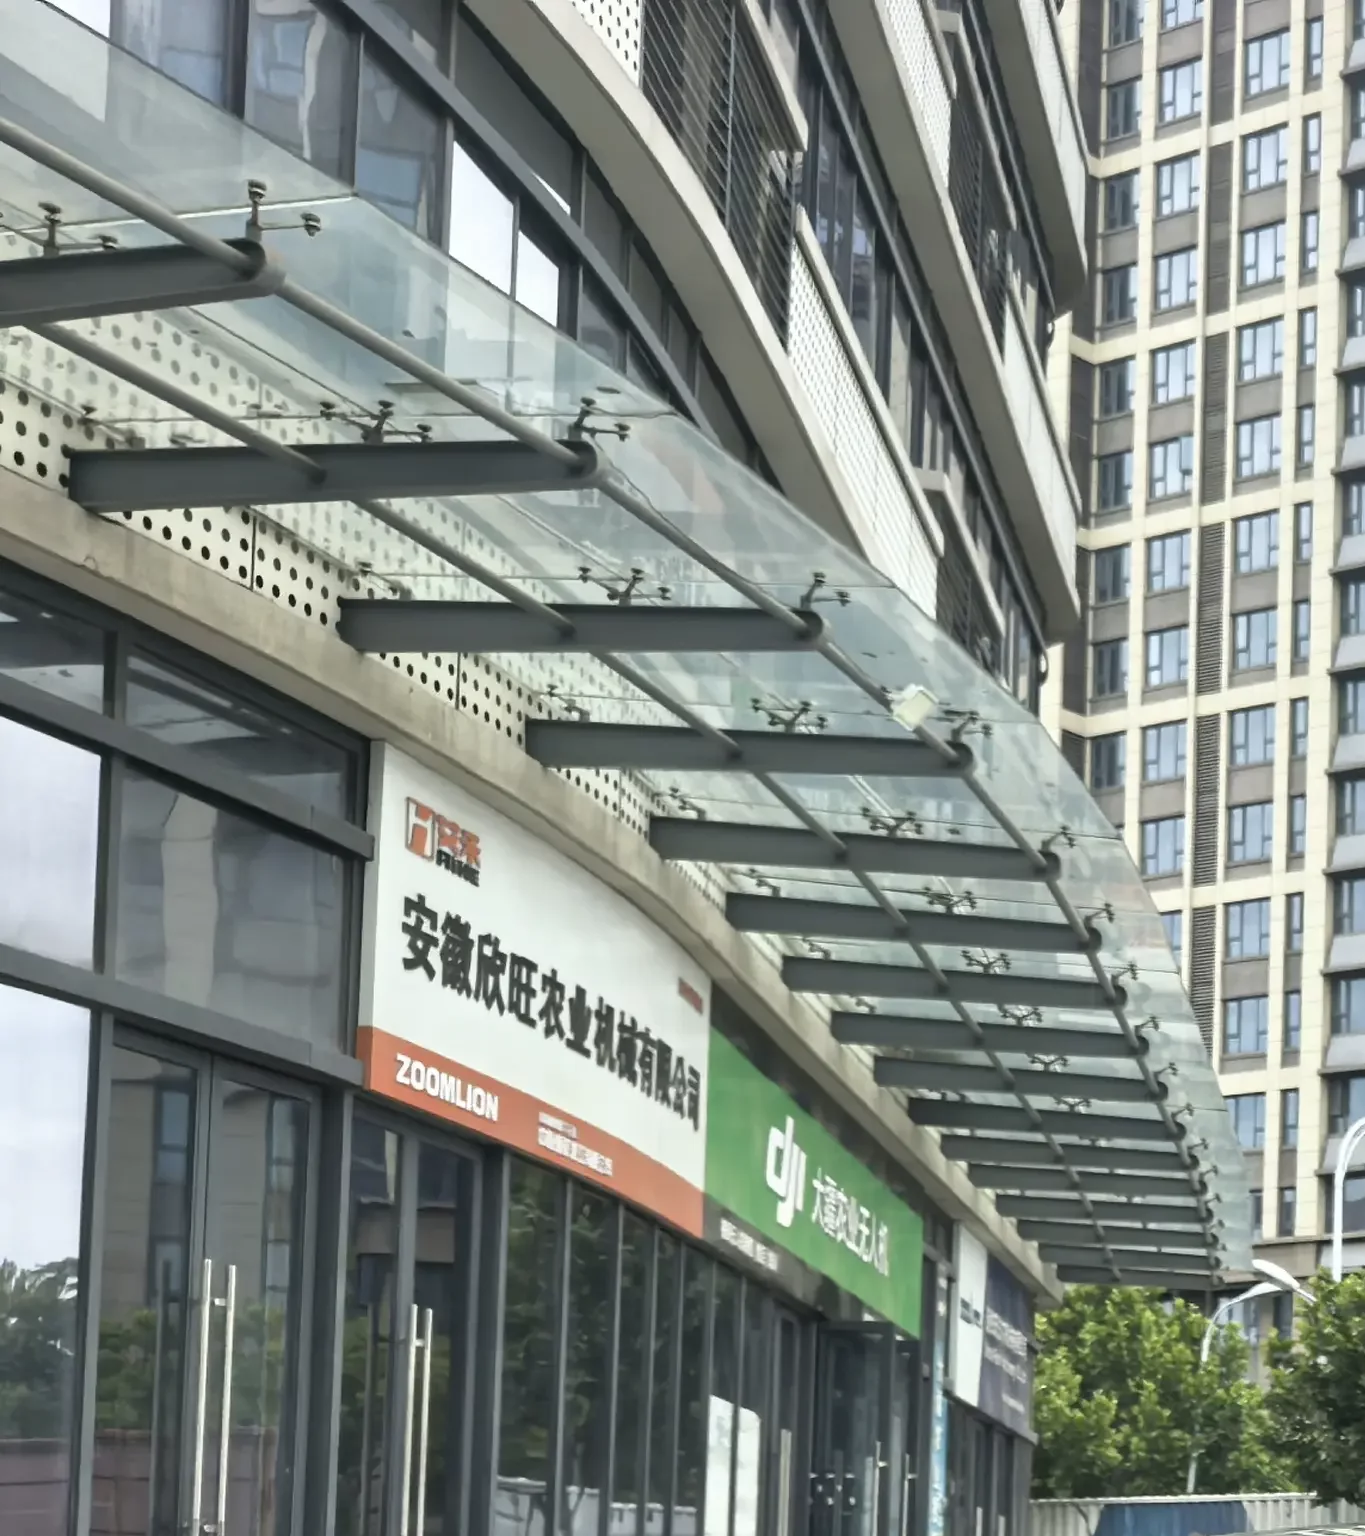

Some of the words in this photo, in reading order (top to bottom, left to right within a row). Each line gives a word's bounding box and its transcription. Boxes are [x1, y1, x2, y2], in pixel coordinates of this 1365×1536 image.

[396, 1053, 498, 1122] ZOOMLION
[401, 893, 701, 1132] 安徽欣旺农业机械有限公司
